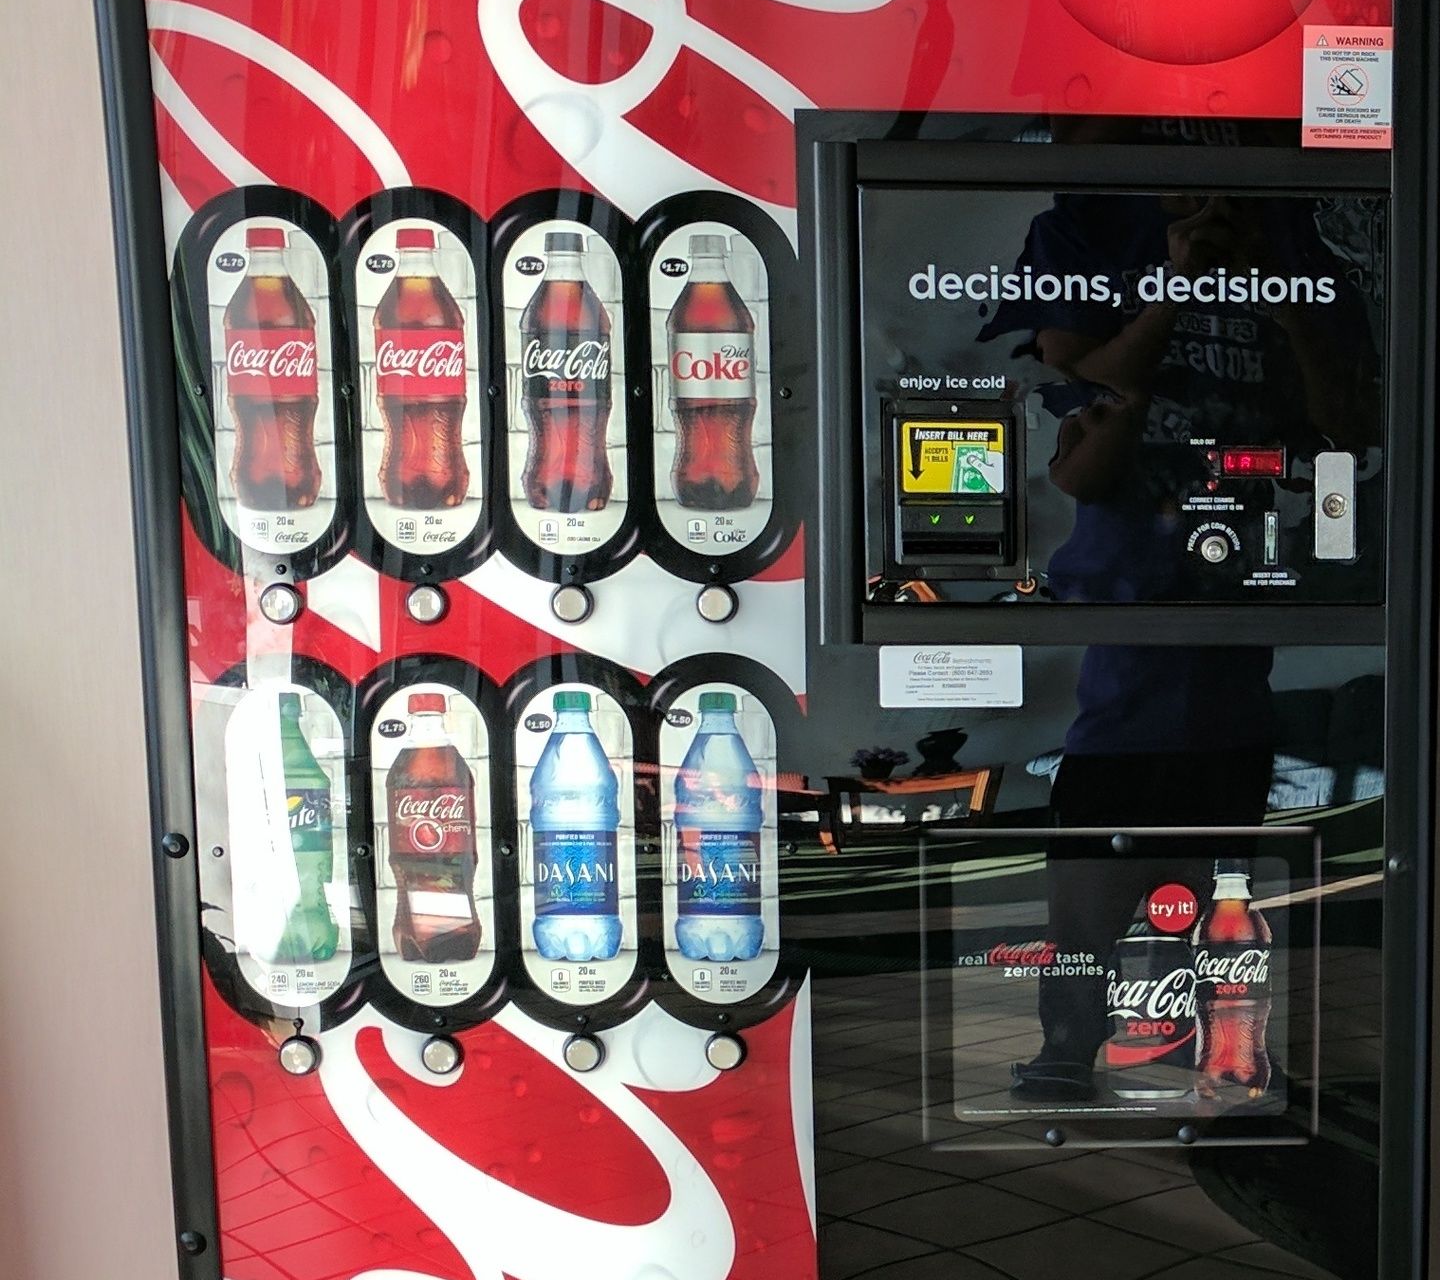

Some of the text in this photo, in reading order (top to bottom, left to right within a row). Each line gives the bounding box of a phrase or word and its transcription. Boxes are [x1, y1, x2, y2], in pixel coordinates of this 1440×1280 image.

[1335, 37, 1384, 46] WARNING
[217, 256, 245, 268] $1.75
[366, 257, 394, 269] $1.75
[516, 258, 544, 272] $1.75
[661, 260, 688, 273] $1.75
[908, 264, 1335, 307] decisions, decisions
[376, 339, 464, 377] Coca-Cola
[721, 345, 750, 358] Diet
[227, 339, 316, 378] Coca-Cola
[523, 338, 610, 381] Coca-Cola
[671, 352, 750, 381] Coke
[548, 380, 585, 391] zero
[900, 375, 1005, 390] enjoy ice cold
[915, 428, 989, 440] INSERT BILL HERE
[399, 522, 414, 531] 240
[424, 516, 435, 525] 20
[713, 531, 746, 543] Coke
[526, 718, 550, 730] $1.50
[667, 712, 691, 725] $1.50
[380, 722, 405, 733] $1.75
[398, 795, 465, 820] Coca-Cola
[443, 822, 471, 835] cherry
[538, 857, 613, 885] DASANI
[681, 857, 757, 886] DASANI
[1150, 901, 1194, 917] try it!
[958, 953, 987, 965] real
[1056, 952, 1095, 964] taste
[1004, 964, 1103, 977] zero calories
[1195, 950, 1269, 985] Coca-Cola
[414, 975, 429, 983] 260
[1216, 983, 1247, 994] zero
[1127, 1020, 1175, 1037] zero
